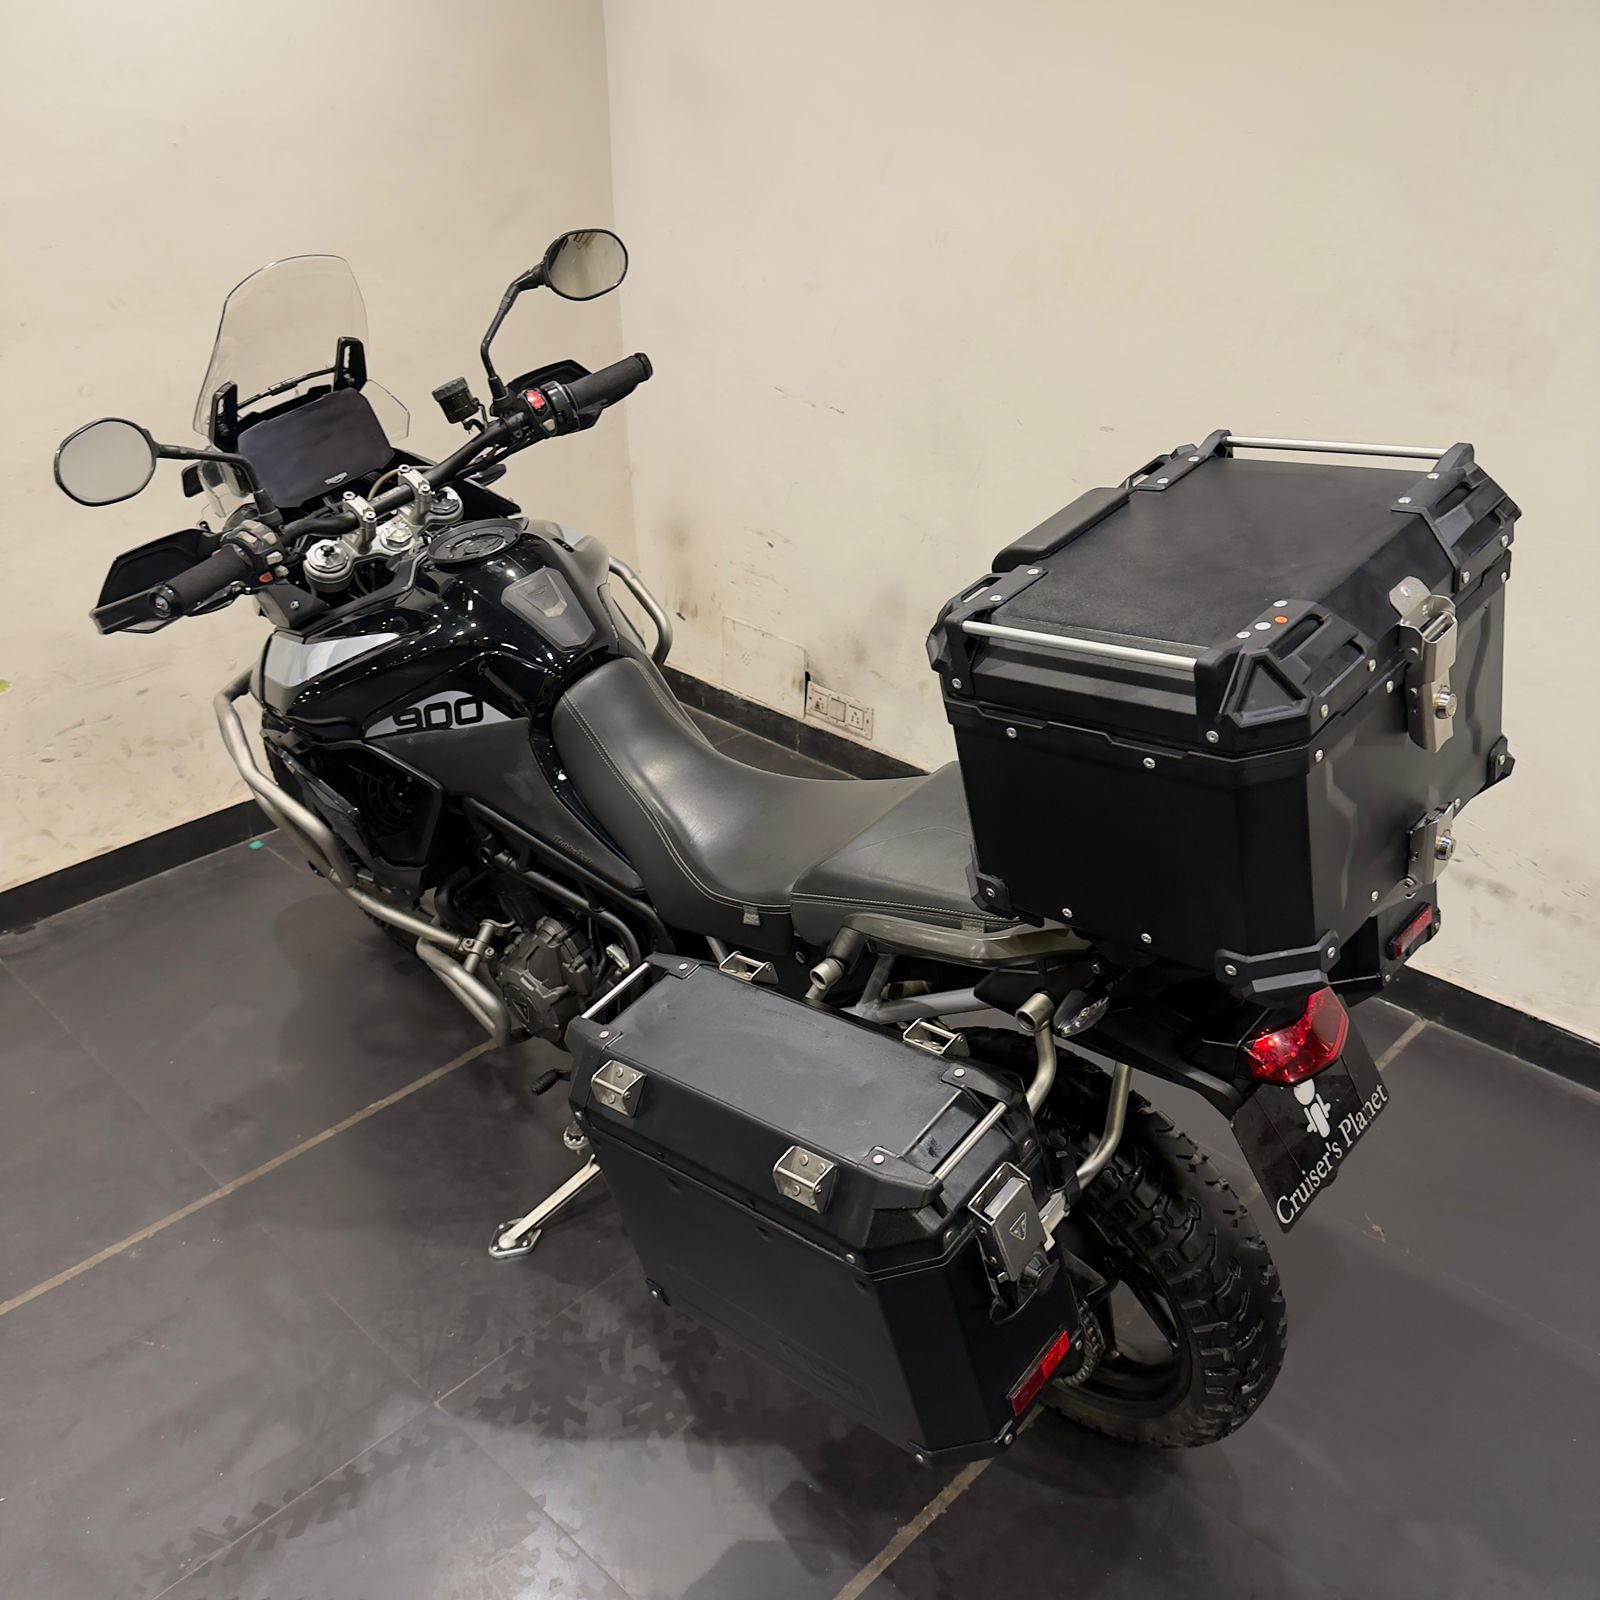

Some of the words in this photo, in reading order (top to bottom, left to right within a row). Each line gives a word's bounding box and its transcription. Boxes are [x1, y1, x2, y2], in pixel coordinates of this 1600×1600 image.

[393, 696, 484, 732] 900
[1276, 1142, 1343, 1224] Cruiser's
[1338, 1084, 1388, 1148] Planet
